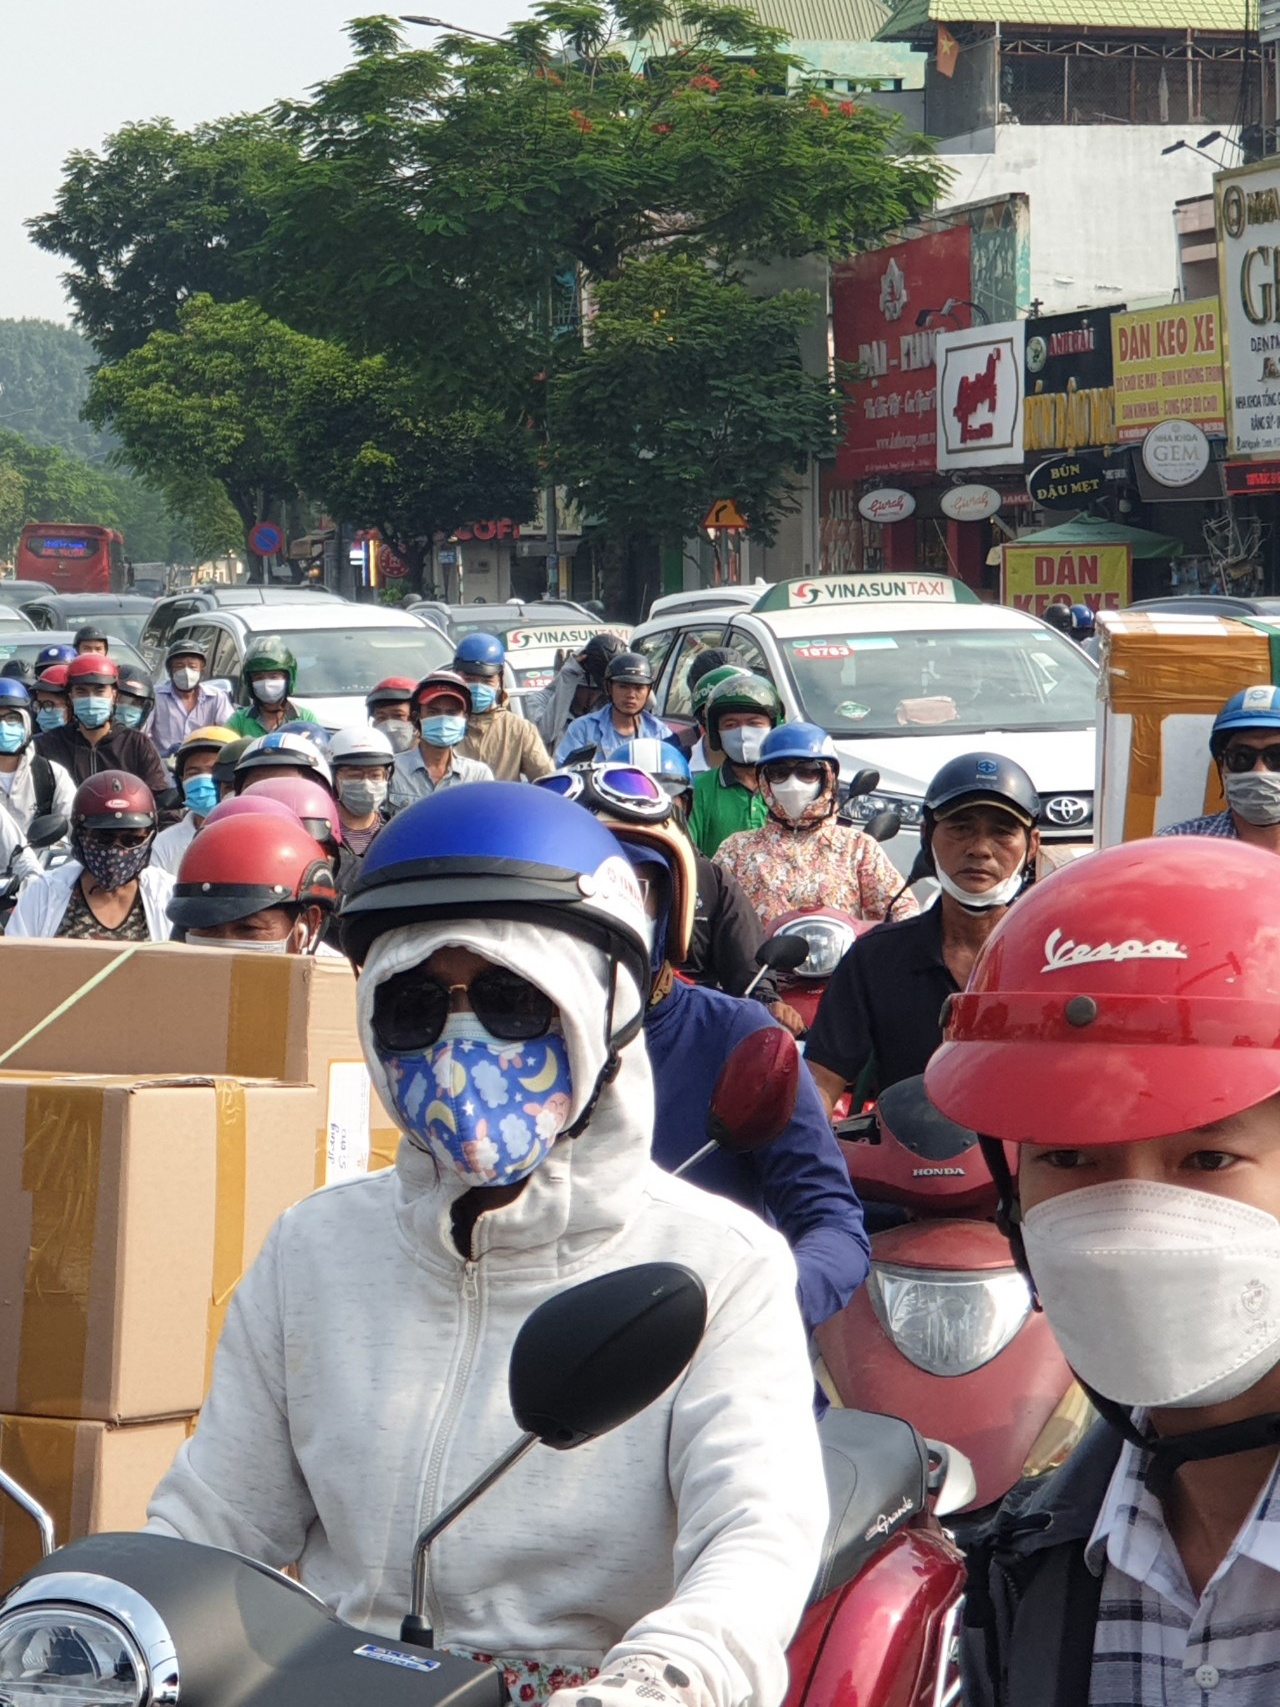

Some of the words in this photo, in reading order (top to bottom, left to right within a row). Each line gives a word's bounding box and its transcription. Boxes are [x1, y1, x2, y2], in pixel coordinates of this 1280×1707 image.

[1118, 315, 1152, 362] DÁN
[1156, 317, 1189, 358] KEO
[1193, 313, 1216, 355] XE
[1175, 433, 1199, 442] KHOA
[1153, 445, 1200, 462] GEM
[1050, 463, 1080, 480] BÚN
[1037, 484, 1068, 501] ĐẬU
[1071, 478, 1100, 494] MẸT
[1034, 551, 1099, 586] DÁN
[1040, 928, 1188, 973] Vespa
[912, 1167, 966, 1177] HONDA
